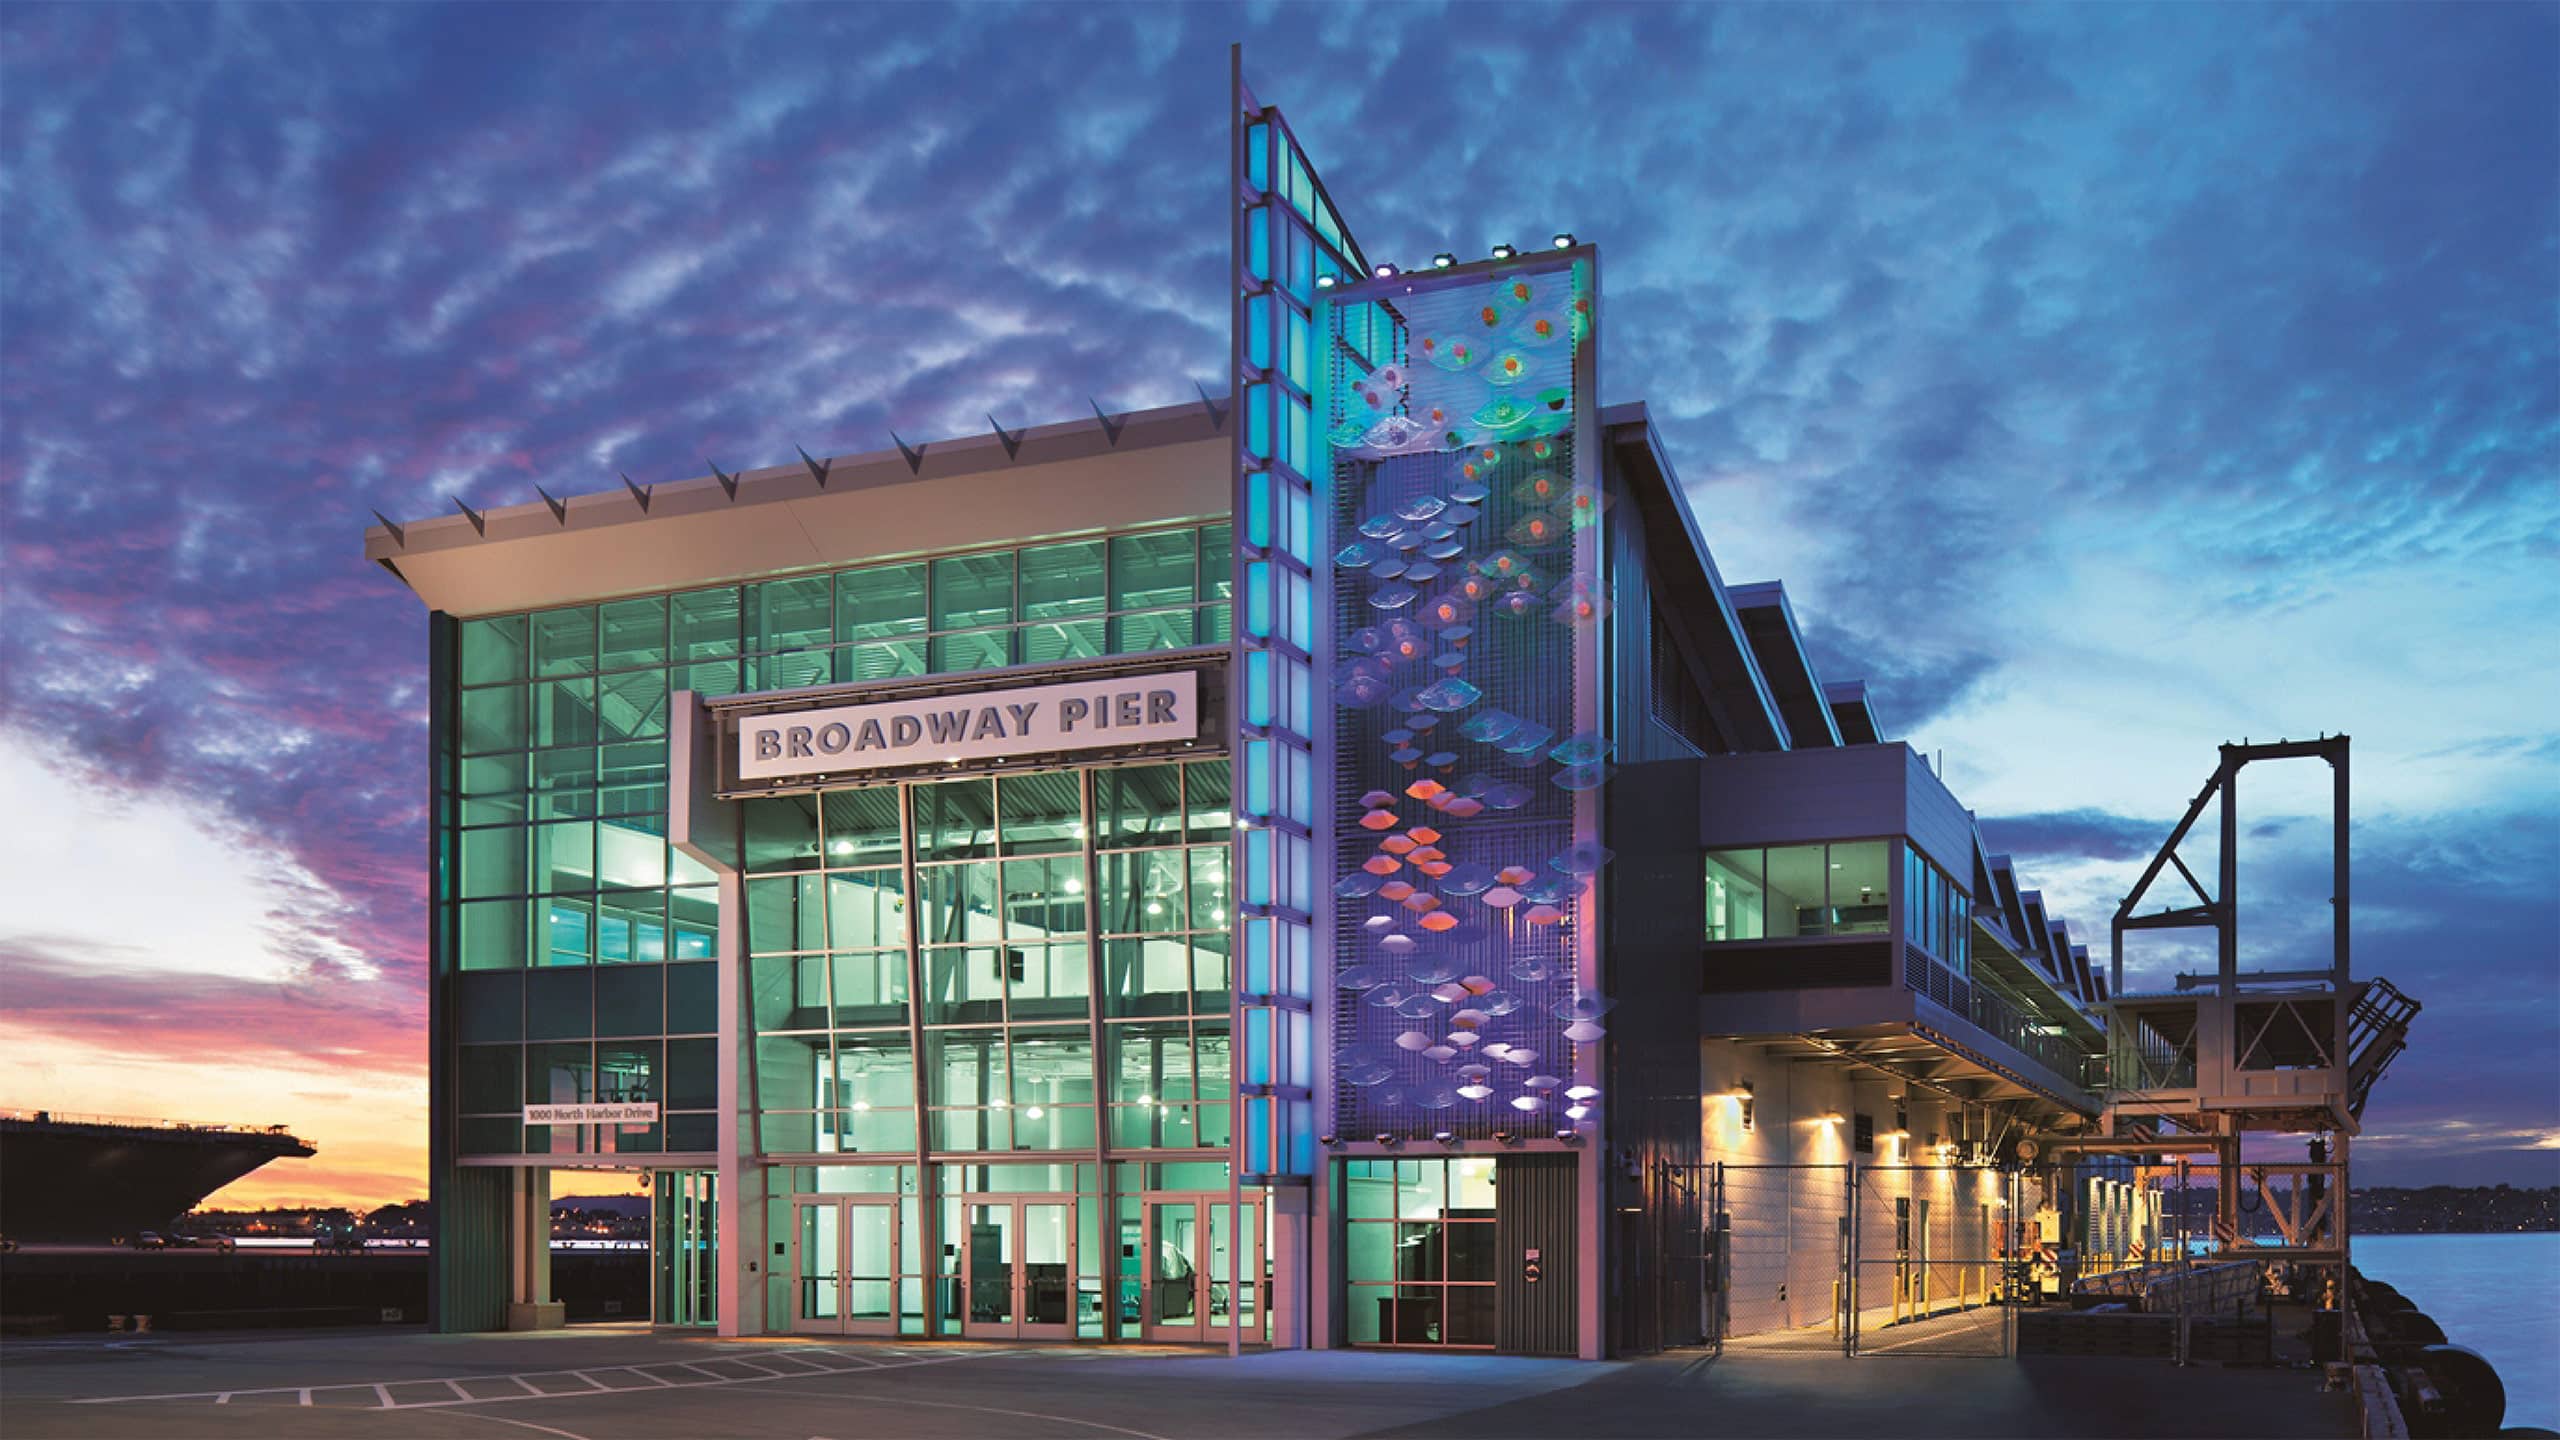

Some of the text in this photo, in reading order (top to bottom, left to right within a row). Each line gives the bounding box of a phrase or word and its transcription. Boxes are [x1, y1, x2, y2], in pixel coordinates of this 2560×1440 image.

[755, 690, 1178, 761] BROADWAY PIER
[529, 1107, 653, 1121] 1000 North Harbor Drive
